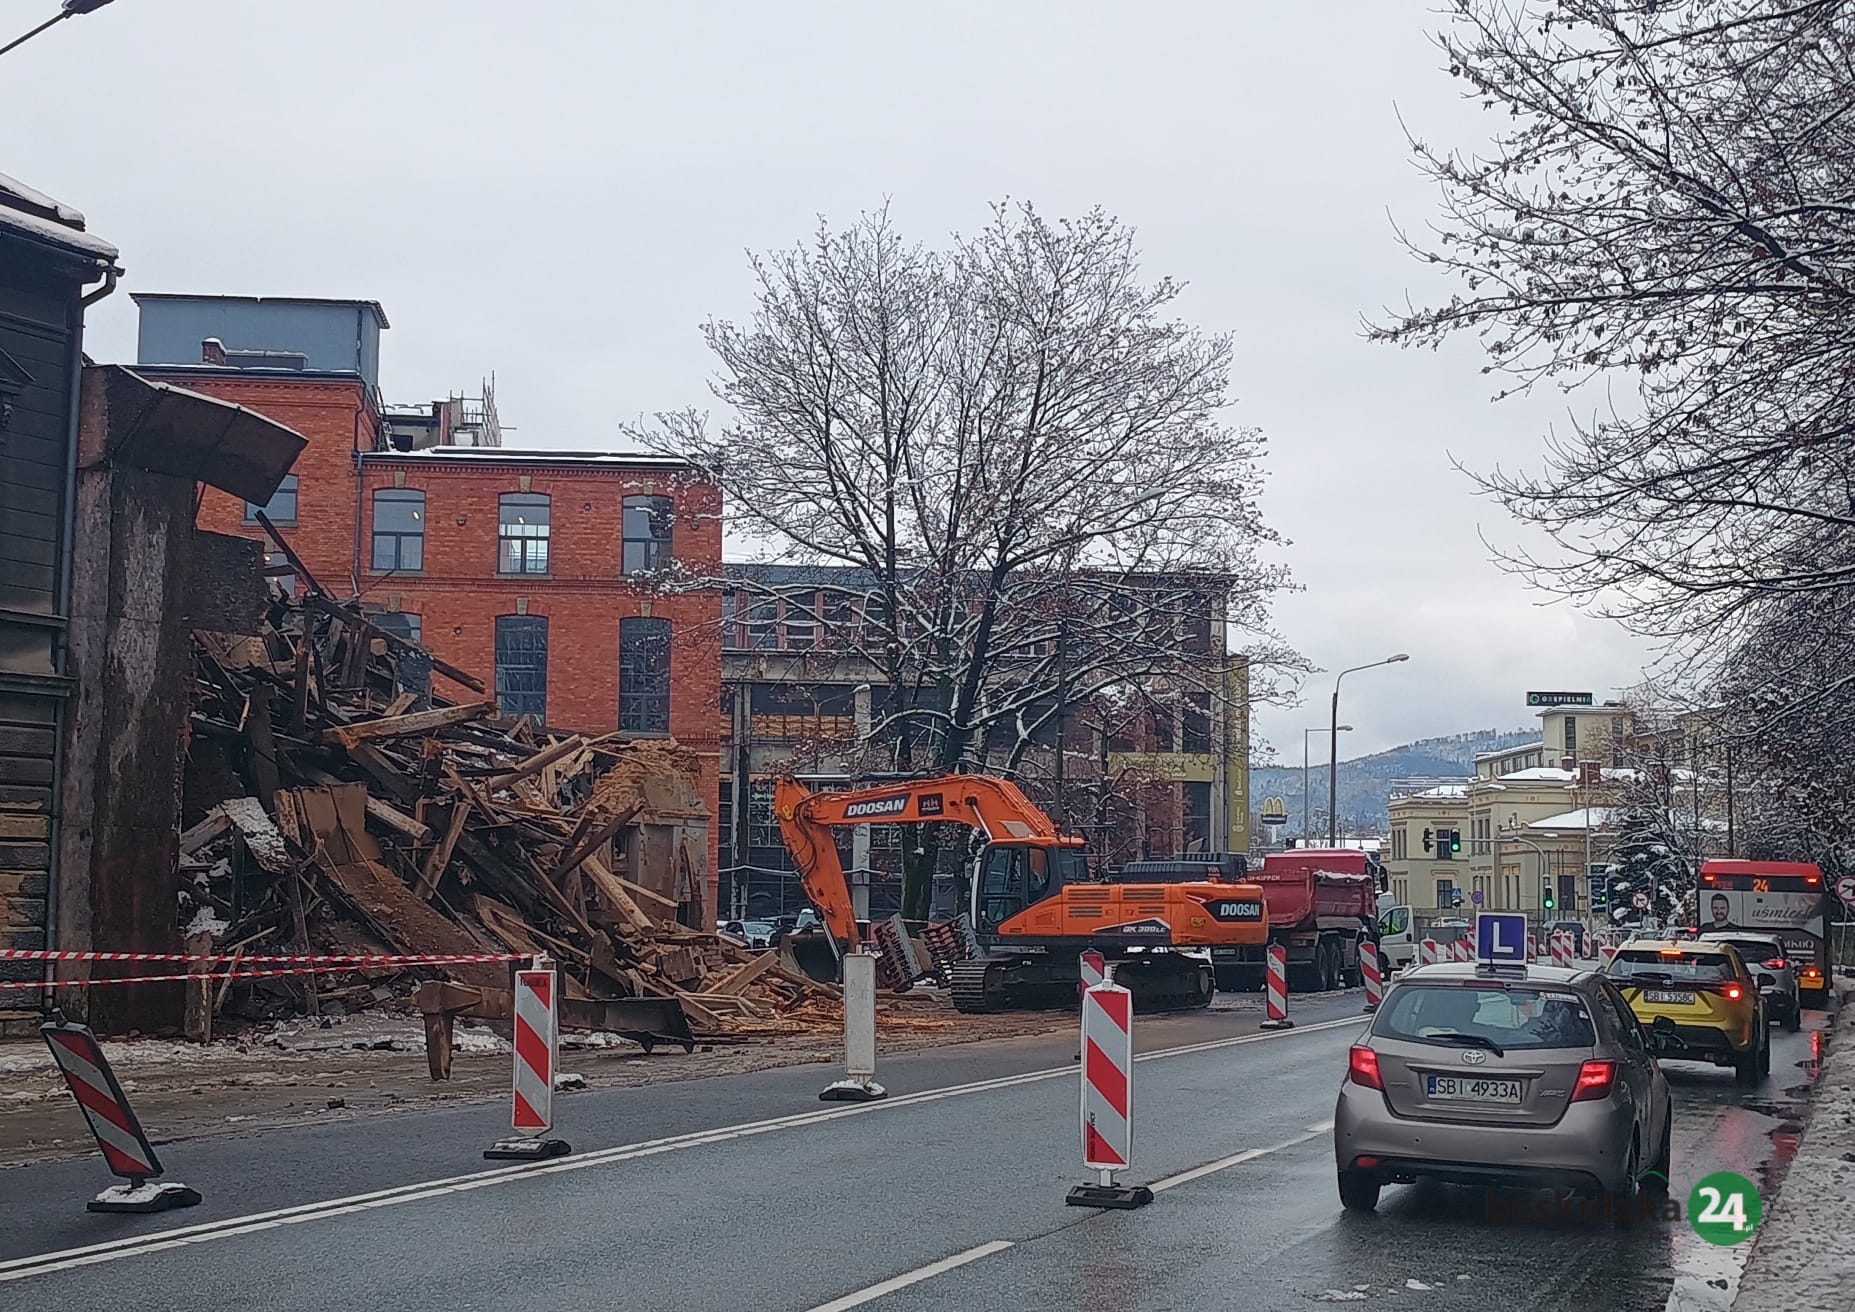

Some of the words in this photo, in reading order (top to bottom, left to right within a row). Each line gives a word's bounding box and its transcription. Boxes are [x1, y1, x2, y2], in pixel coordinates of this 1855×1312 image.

[847, 798, 905, 816] DOOSAN
[1752, 878, 1769, 893] 24
[1220, 903, 1260, 917] DOOSAN
[1492, 921, 1514, 954] L
[1437, 1078, 1464, 1095] SBI
[1470, 1081, 1519, 1099] 4933A
